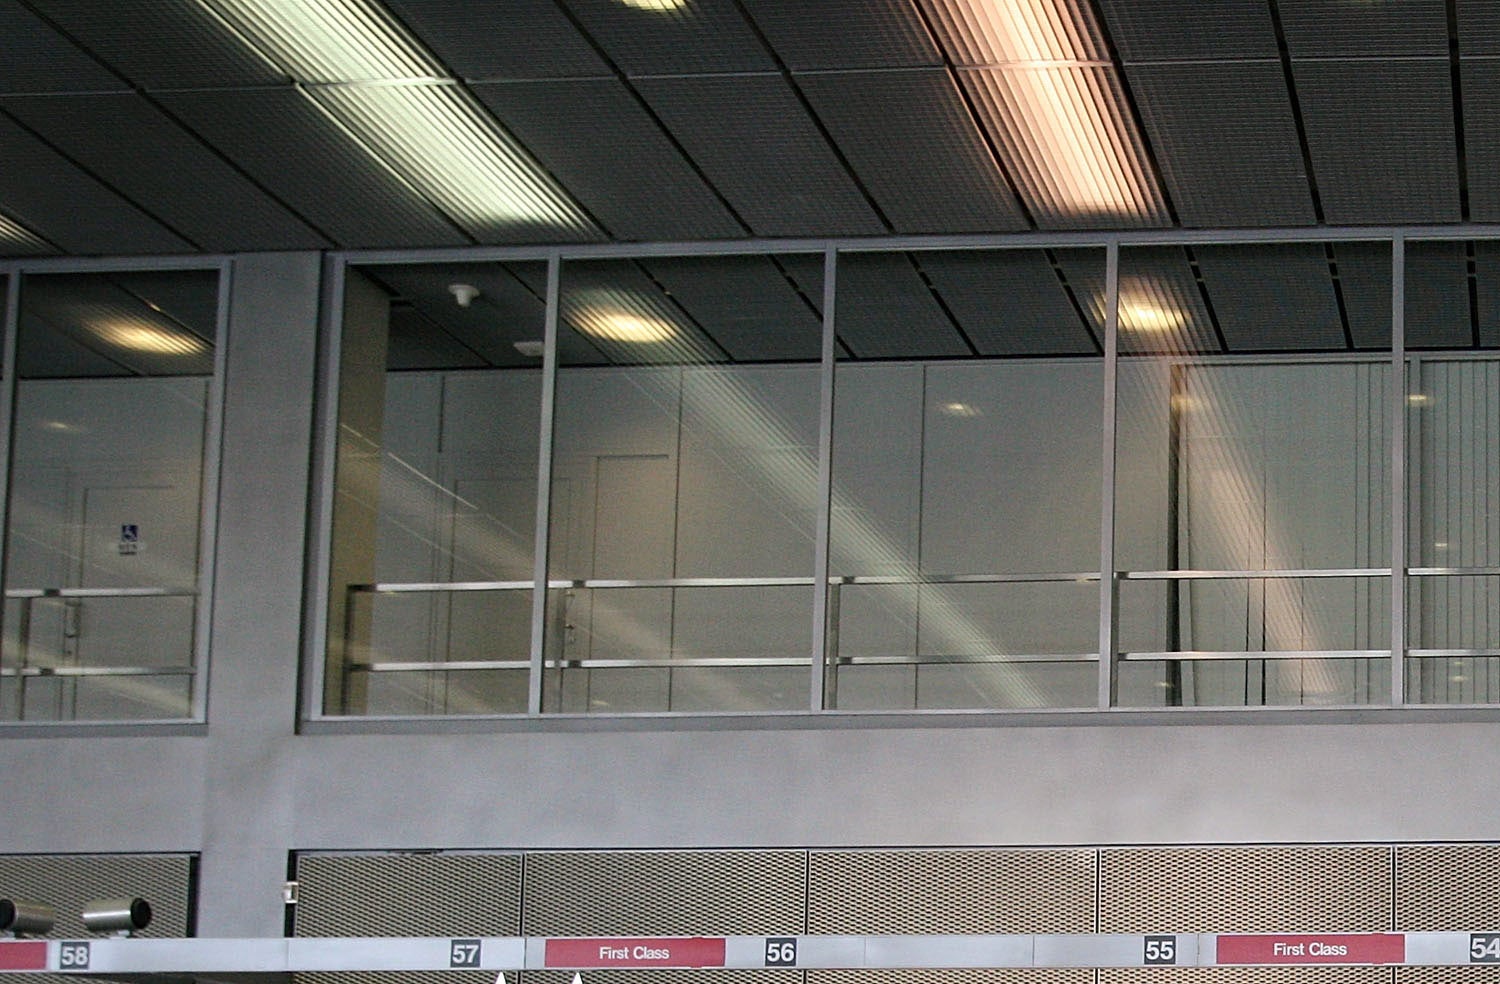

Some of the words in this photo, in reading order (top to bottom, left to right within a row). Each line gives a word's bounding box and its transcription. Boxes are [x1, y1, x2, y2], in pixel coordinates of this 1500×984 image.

[62, 946, 88, 965] 58
[452, 944, 479, 964] 57
[599, 946, 629, 960] First
[633, 946, 670, 960] Class
[767, 942, 795, 962] 56
[1146, 941, 1174, 960] 55
[1273, 942, 1305, 956] First
[1309, 942, 1348, 956] Class
[1471, 937, 1500, 957] 54
